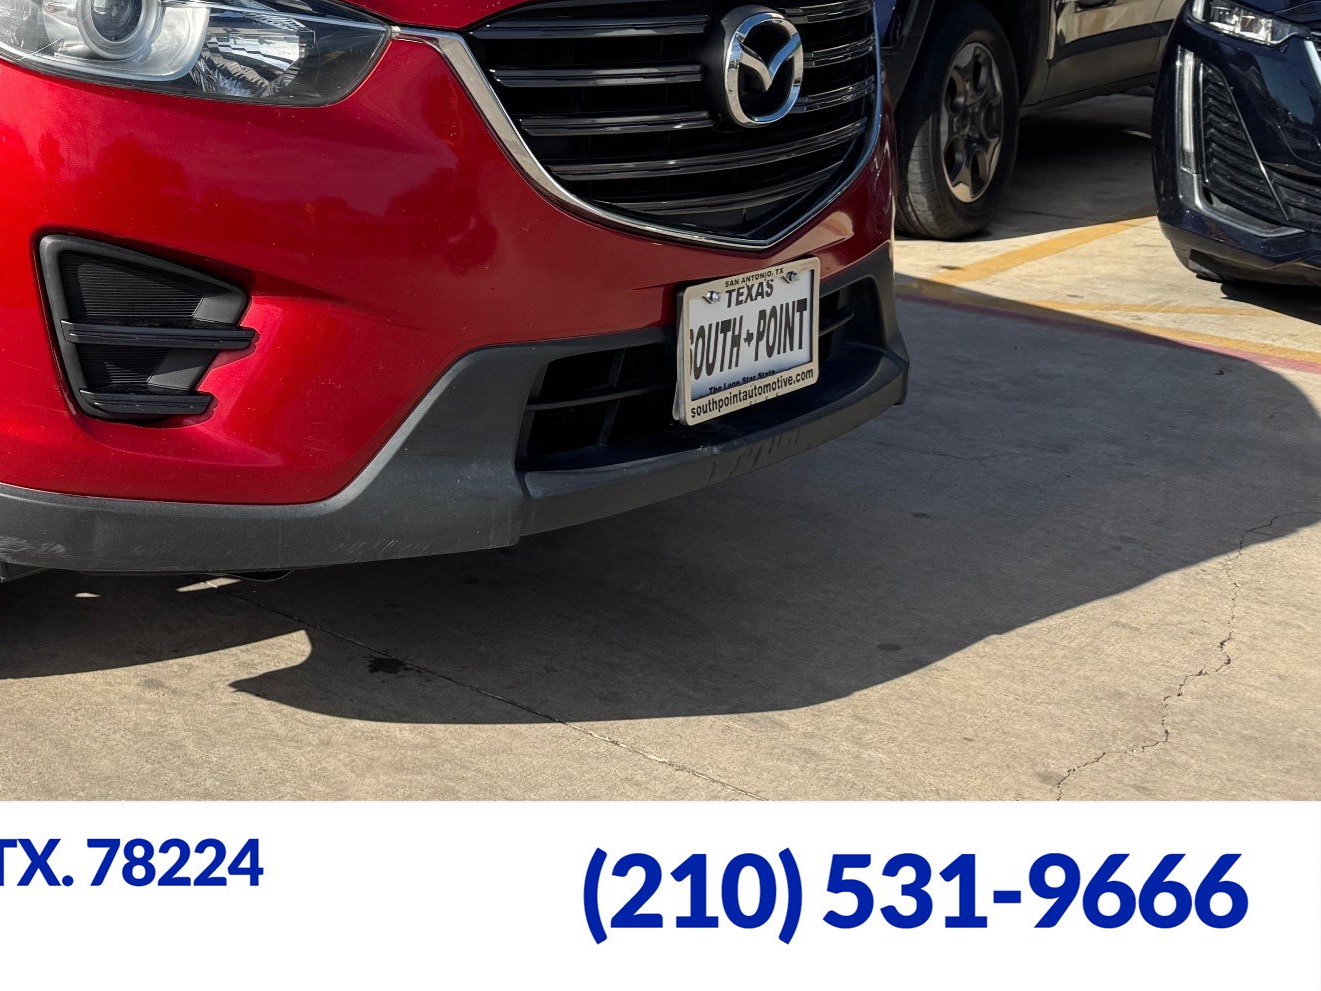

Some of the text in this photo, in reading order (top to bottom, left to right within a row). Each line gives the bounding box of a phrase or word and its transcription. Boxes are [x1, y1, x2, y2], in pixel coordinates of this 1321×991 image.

[725, 279, 739, 288] SAN
[775, 267, 784, 275] TX
[725, 279, 774, 308] TEXAS
[754, 298, 808, 361] POINT
[690, 369, 814, 418] southpointautomotive.com
[709, 385, 722, 396] The
[742, 374, 757, 384] Star
